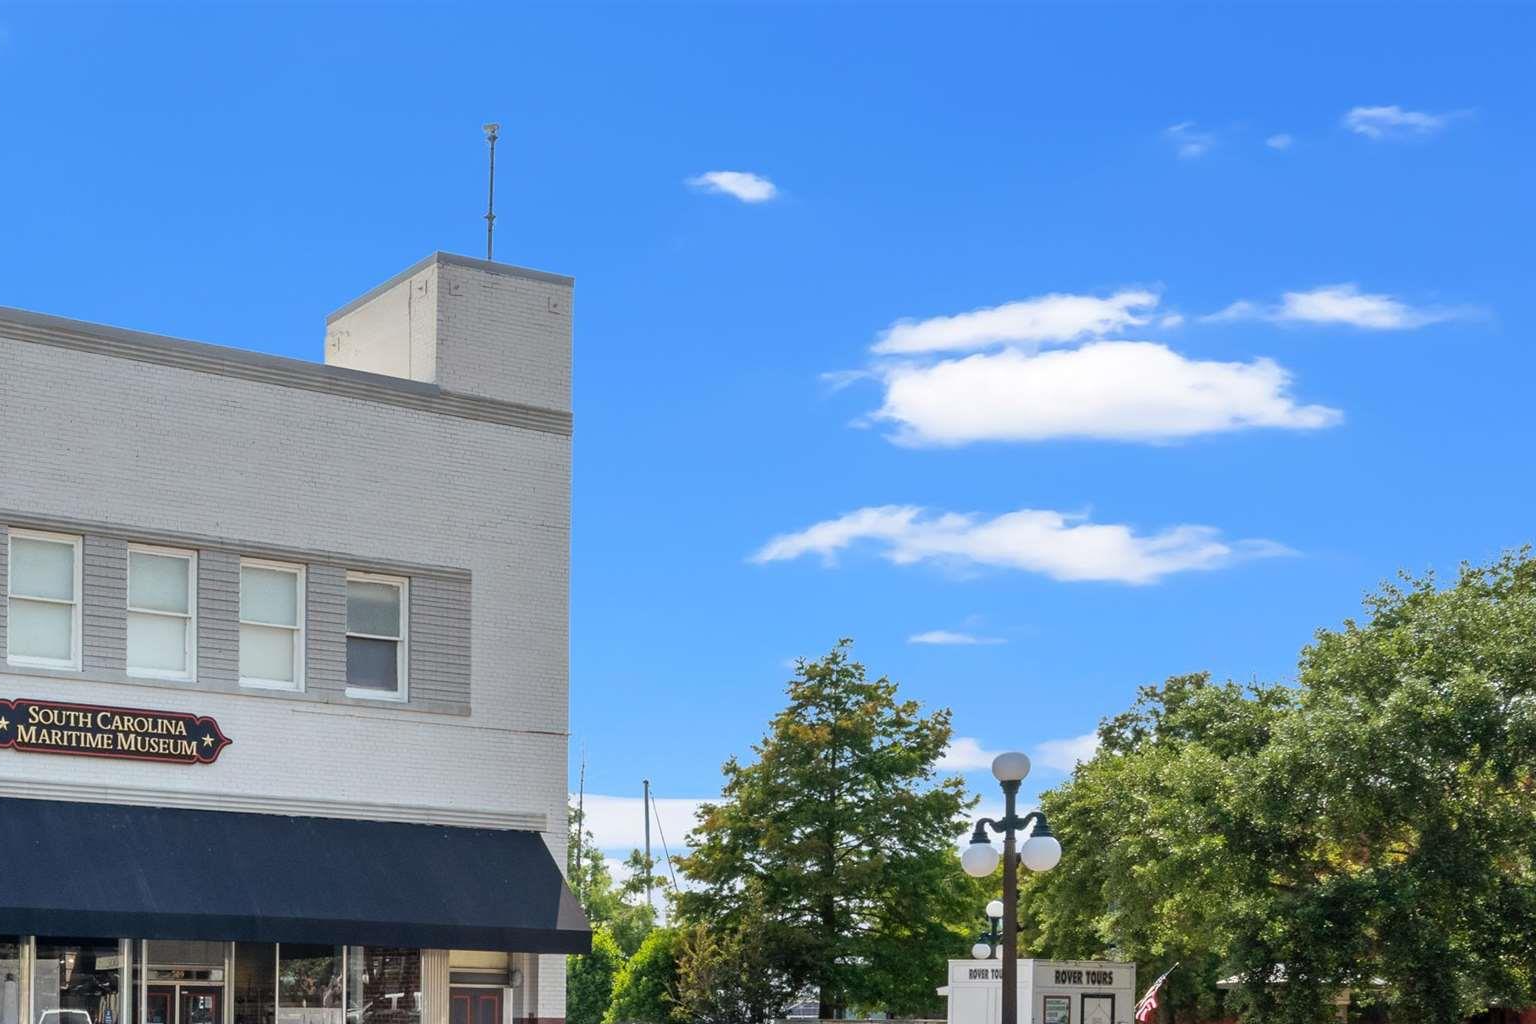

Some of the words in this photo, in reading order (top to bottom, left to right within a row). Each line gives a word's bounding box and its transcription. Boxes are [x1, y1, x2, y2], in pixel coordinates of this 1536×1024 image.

[28, 706, 92, 729] SOUTH
[96, 711, 187, 736] CAROLINA
[16, 724, 113, 750] MARITIME
[117, 733, 197, 756] MUSEUM
[968, 968, 989, 980] ROVER
[991, 968, 1003, 980] TOU
[1054, 970, 1083, 985] ROVER
[1085, 970, 1113, 986] TOURS
